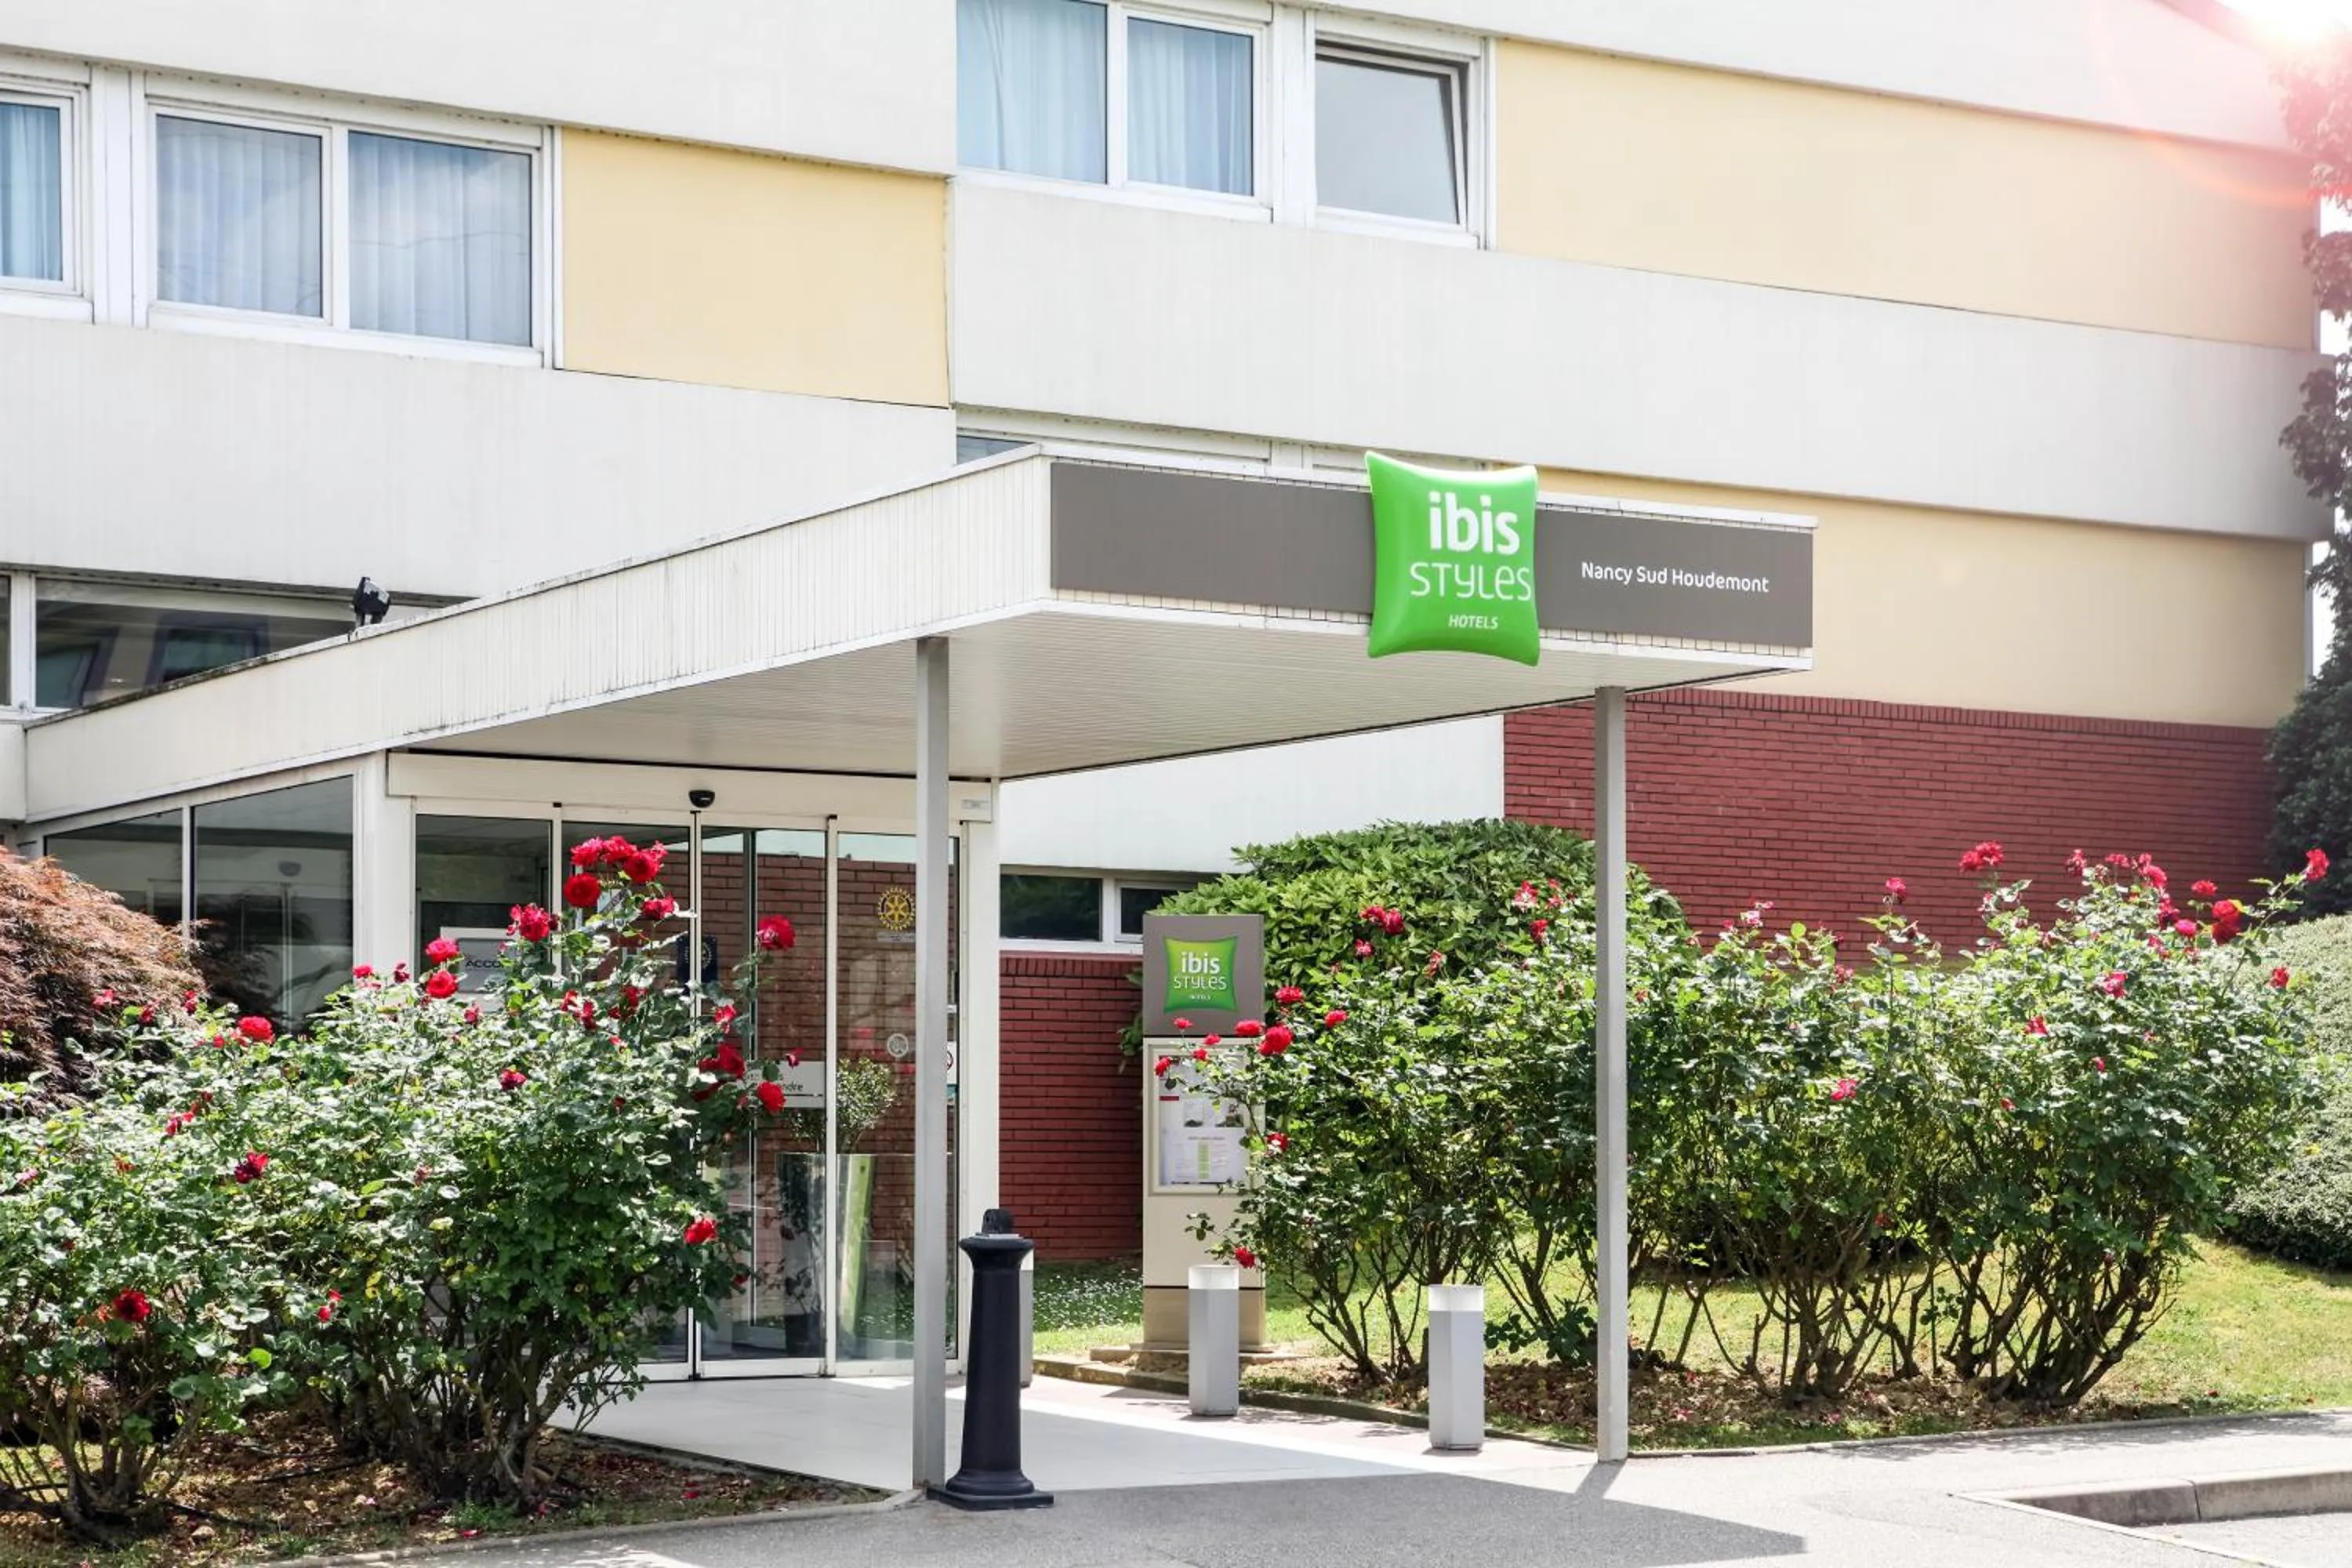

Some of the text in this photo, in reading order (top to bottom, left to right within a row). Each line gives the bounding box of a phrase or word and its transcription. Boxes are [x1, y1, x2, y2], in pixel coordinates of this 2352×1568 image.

[1428, 490, 1520, 555] ibis
[1581, 561, 1769, 593] Nancy Sud Houdemont
[1448, 614, 1499, 630] HOTELS
[465, 960, 503, 968] ACCO
[1181, 951, 1221, 974] ibis
